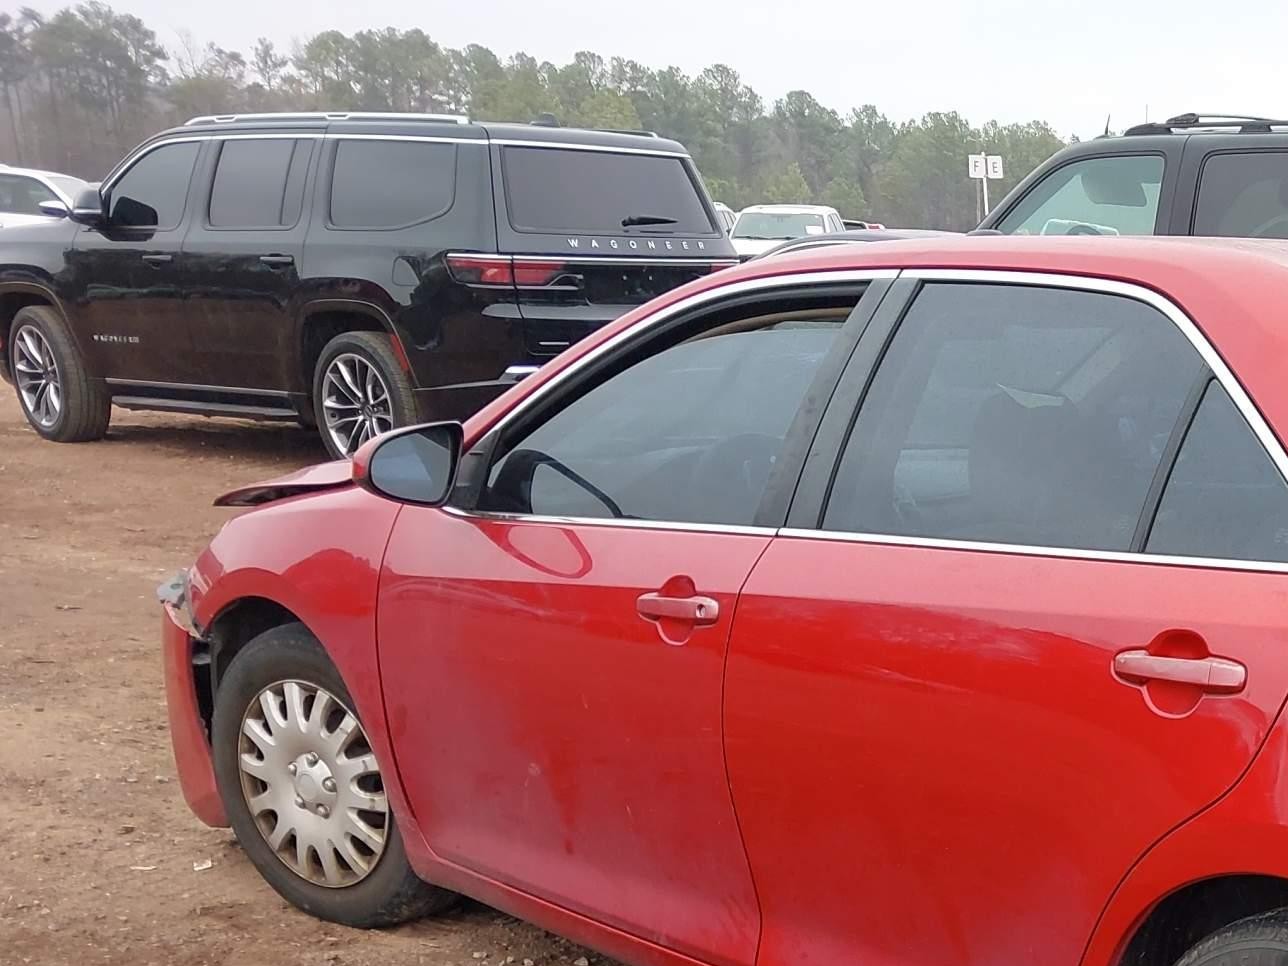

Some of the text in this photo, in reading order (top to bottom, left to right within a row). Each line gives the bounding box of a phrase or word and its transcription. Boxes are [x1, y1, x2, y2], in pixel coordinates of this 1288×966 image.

[973, 160, 980, 173] F
[992, 161, 998, 174] E
[567, 238, 705, 250] WAGONEER
